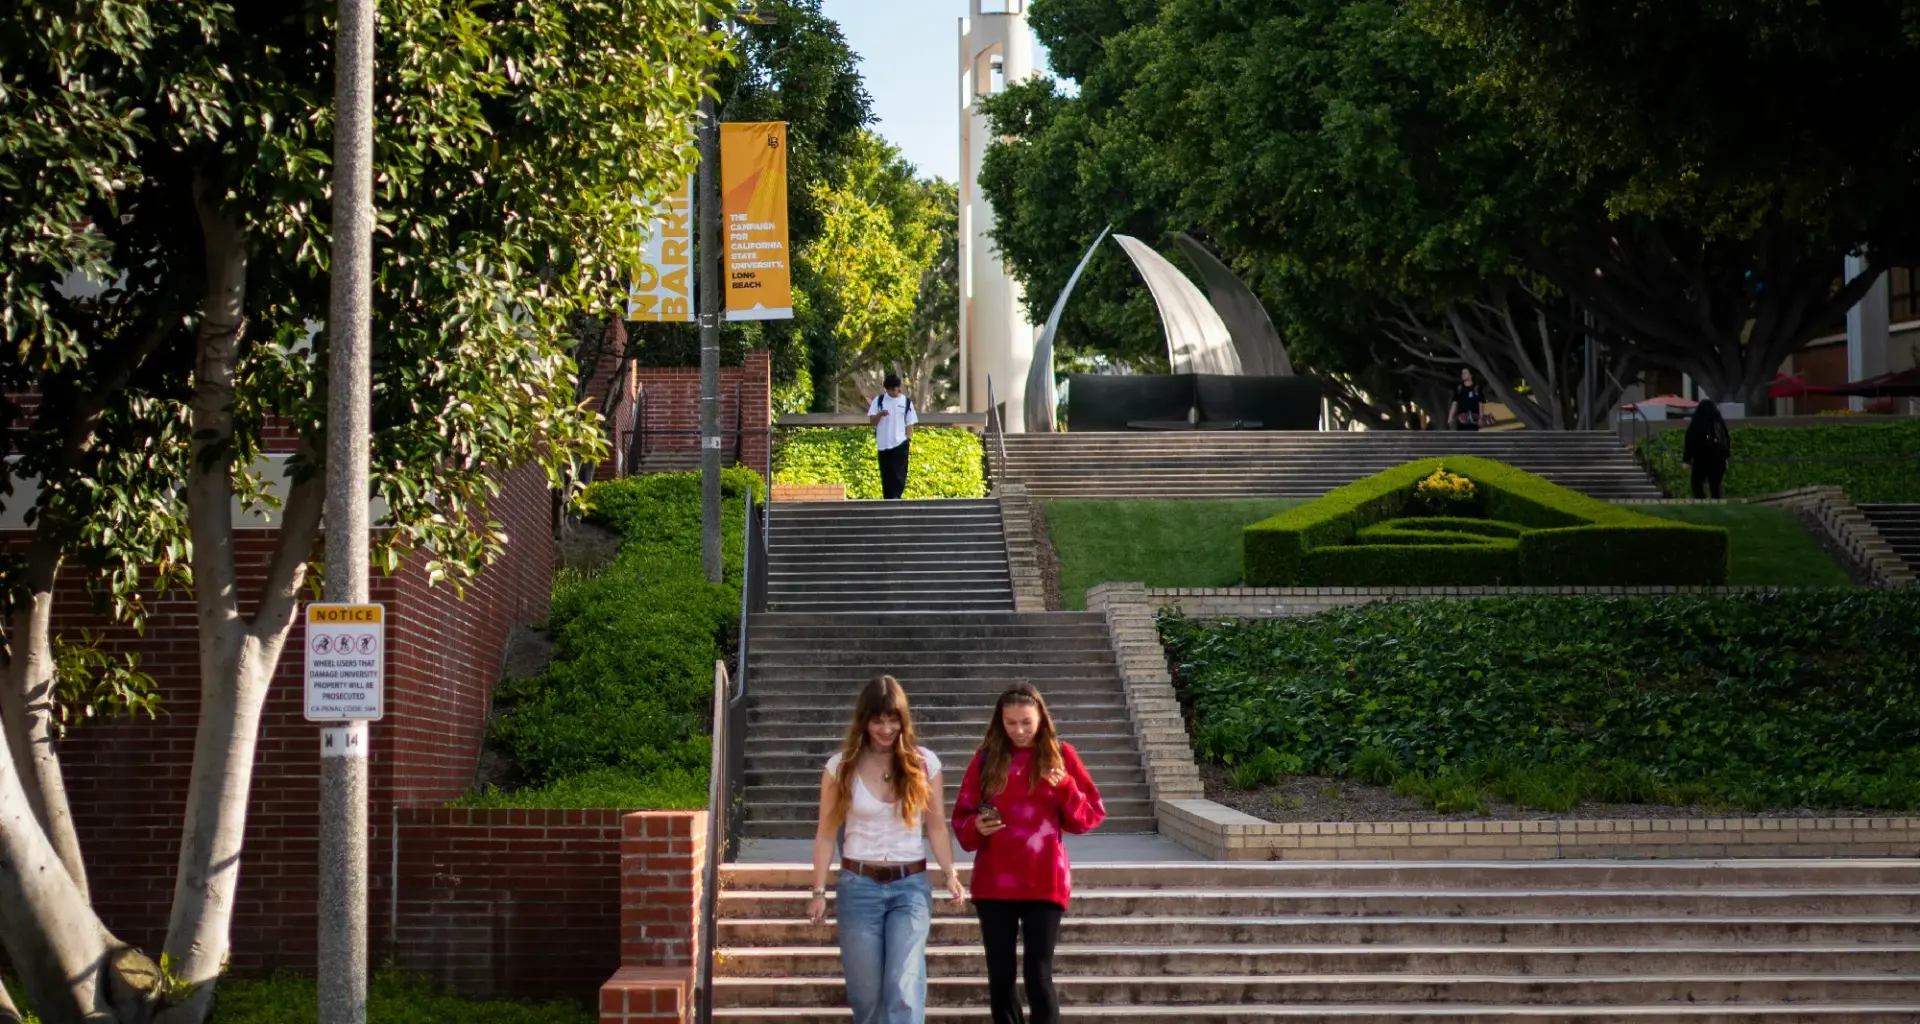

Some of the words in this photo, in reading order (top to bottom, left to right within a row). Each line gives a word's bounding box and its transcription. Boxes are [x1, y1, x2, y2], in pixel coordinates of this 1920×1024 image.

[730, 213, 748, 221] THE
[730, 222, 775, 230] CAMPAIGN
[730, 232, 748, 241] FOR
[730, 241, 783, 249] CALIFORNIA
[731, 252, 757, 260] STATE
[731, 261, 784, 270] UNIVERSITY,
[732, 271, 756, 279] LONG
[732, 281, 761, 289] BEACH
[316, 610, 373, 620] NOTICE
